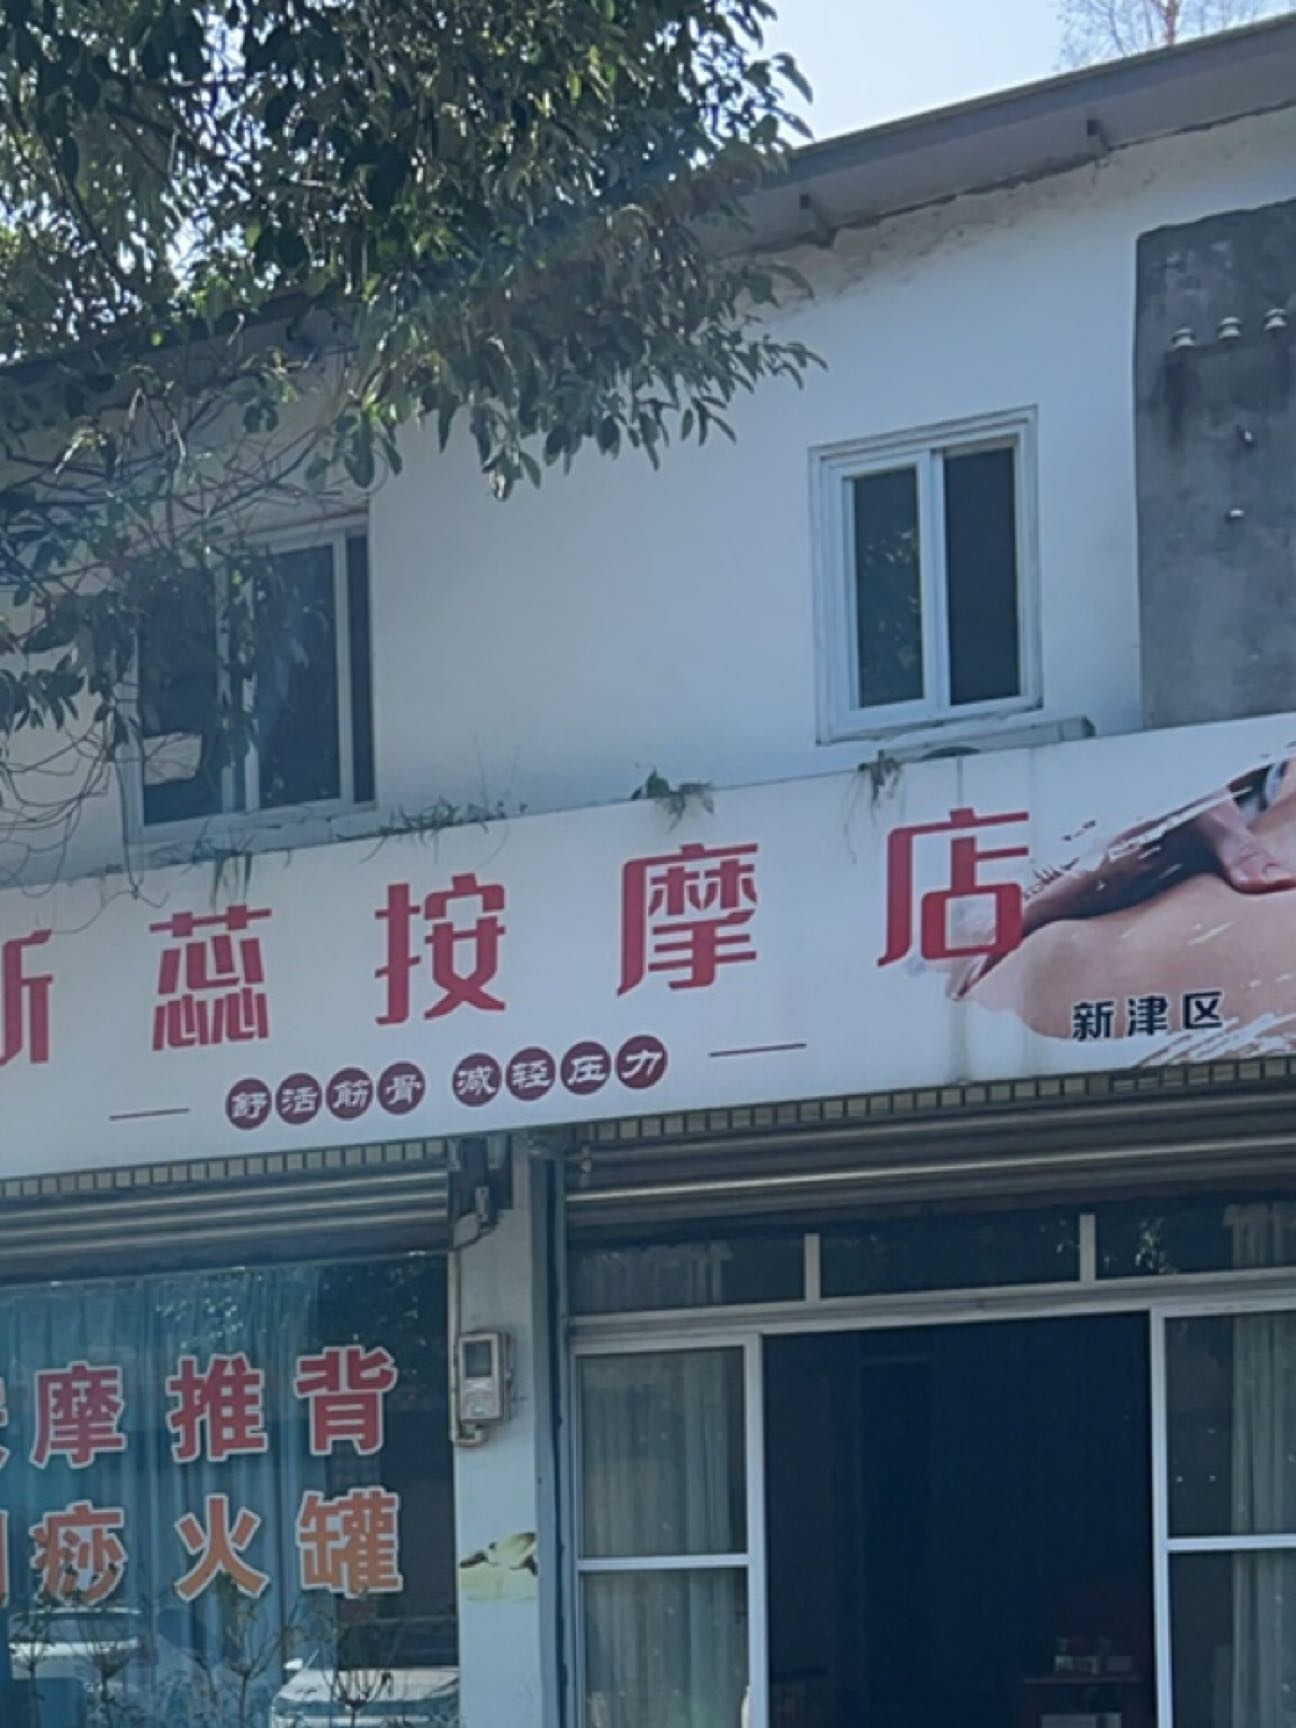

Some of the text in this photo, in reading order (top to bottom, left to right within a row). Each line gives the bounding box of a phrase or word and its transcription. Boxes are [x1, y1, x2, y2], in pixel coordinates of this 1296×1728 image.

[1072, 990, 1223, 1042] 新津区
[228, 1046, 664, 1122] 舒活筋骨 减轻压力
